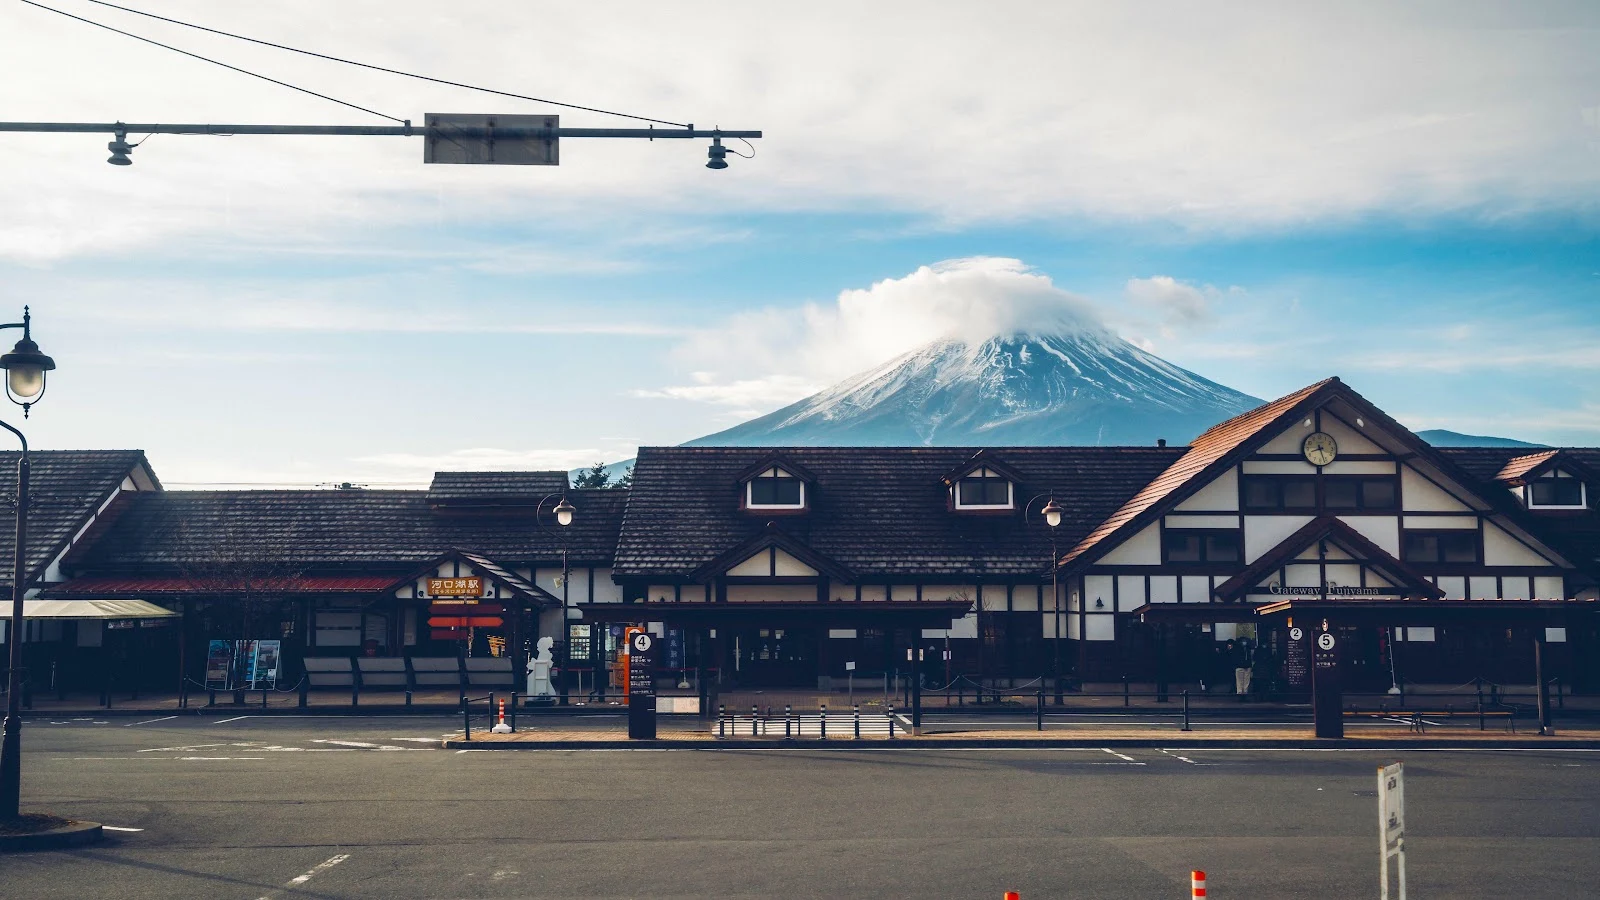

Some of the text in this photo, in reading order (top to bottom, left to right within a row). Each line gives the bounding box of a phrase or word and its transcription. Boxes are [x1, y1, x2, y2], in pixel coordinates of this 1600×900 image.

[431, 579, 479, 588] 河口湖駅
[1269, 580, 1379, 597] Gateway Fujiyama
[1293, 629, 1299, 637] 2
[638, 636, 646, 647] 4
[1322, 635, 1330, 646] 5
